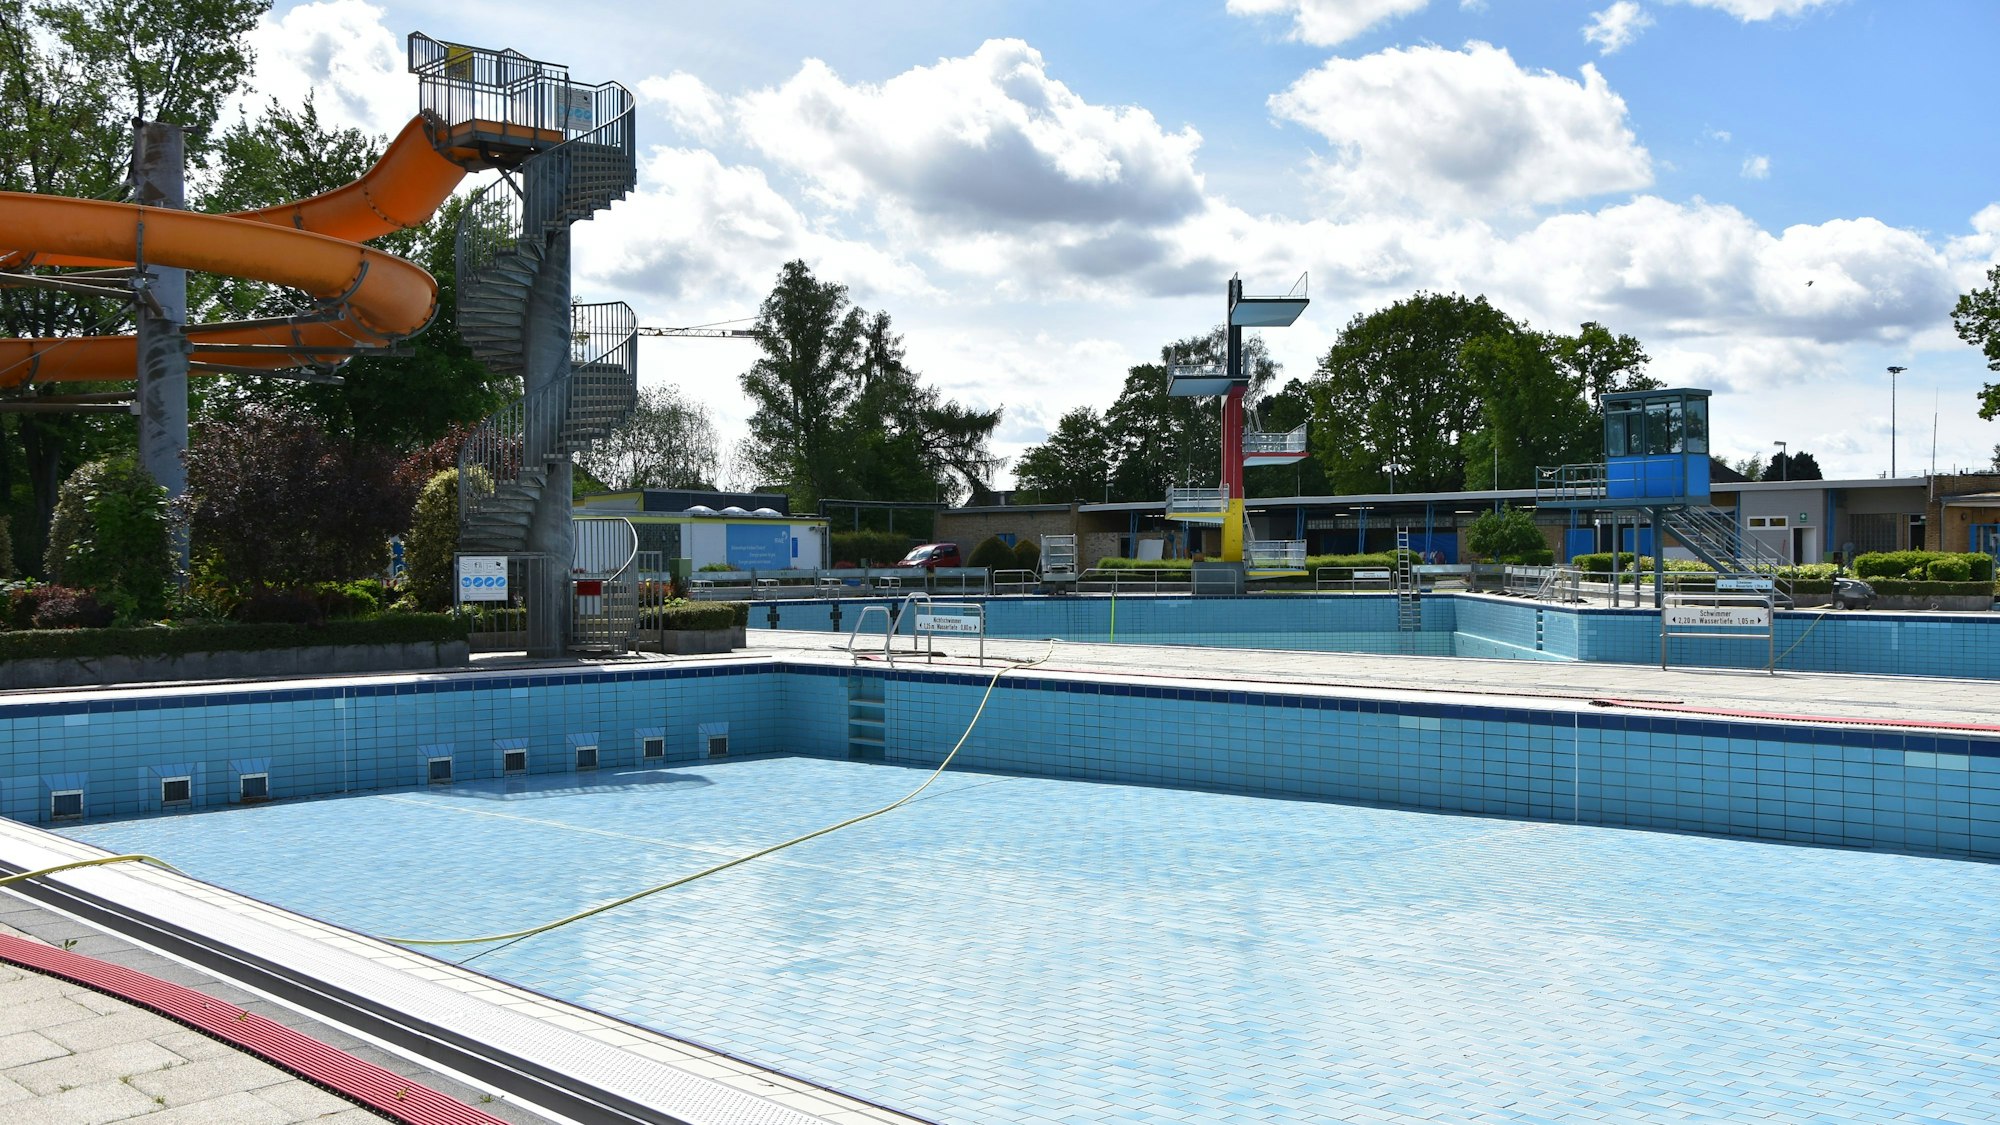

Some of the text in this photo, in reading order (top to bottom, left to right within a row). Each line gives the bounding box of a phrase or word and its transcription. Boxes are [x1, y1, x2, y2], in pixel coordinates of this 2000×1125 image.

[1678, 616, 1691, 624] 2,20
[1699, 617, 1733, 625] Wassertiefe
[1737, 617, 1749, 625] 1,05
